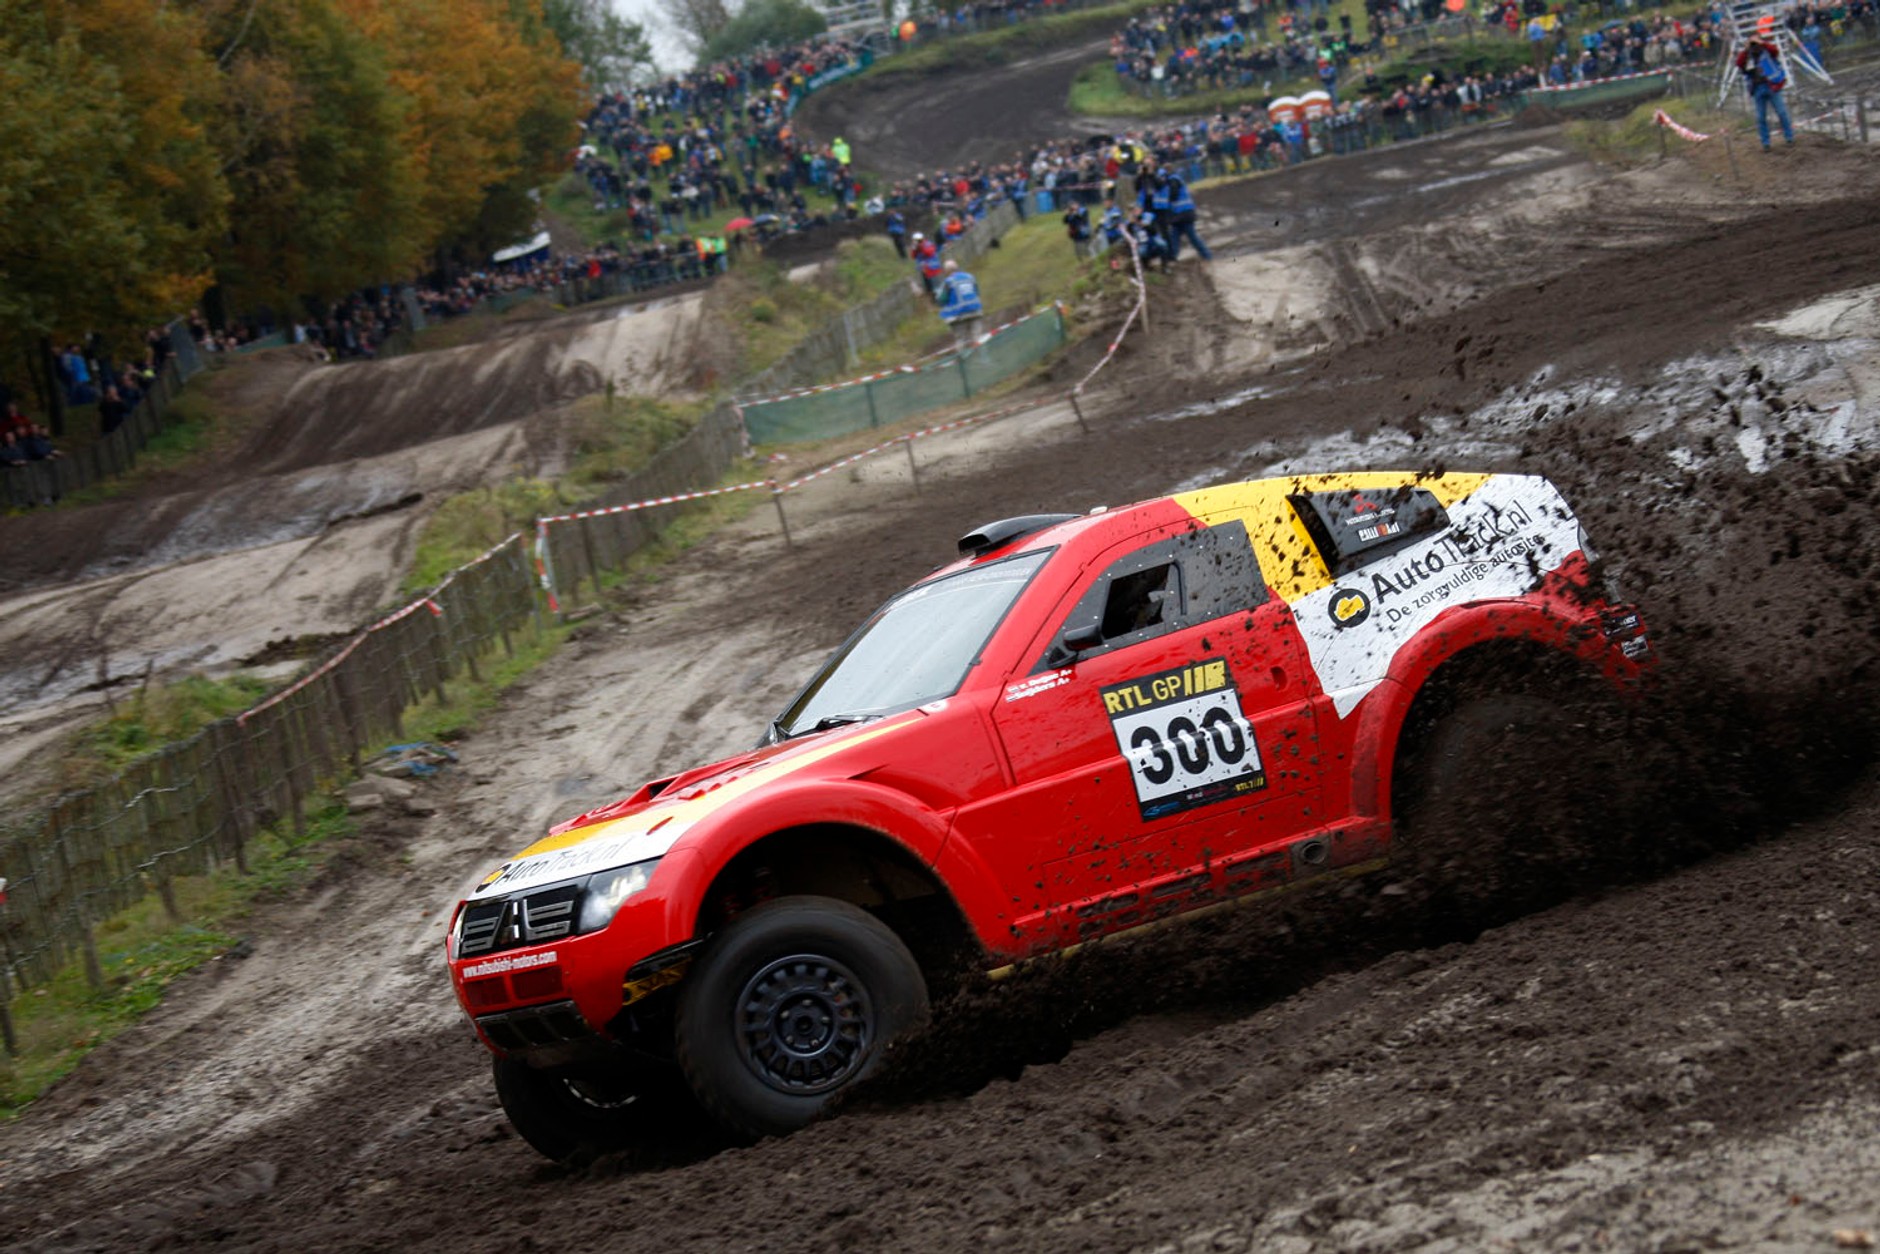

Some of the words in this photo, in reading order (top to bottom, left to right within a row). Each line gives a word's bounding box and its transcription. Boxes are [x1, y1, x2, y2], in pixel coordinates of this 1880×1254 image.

[1386, 605, 1412, 623] De
[1412, 563, 1488, 609] zorgvuldige
[1103, 685, 1152, 714] RTL
[1152, 675, 1181, 701] GP
[1131, 707, 1245, 784] 300
